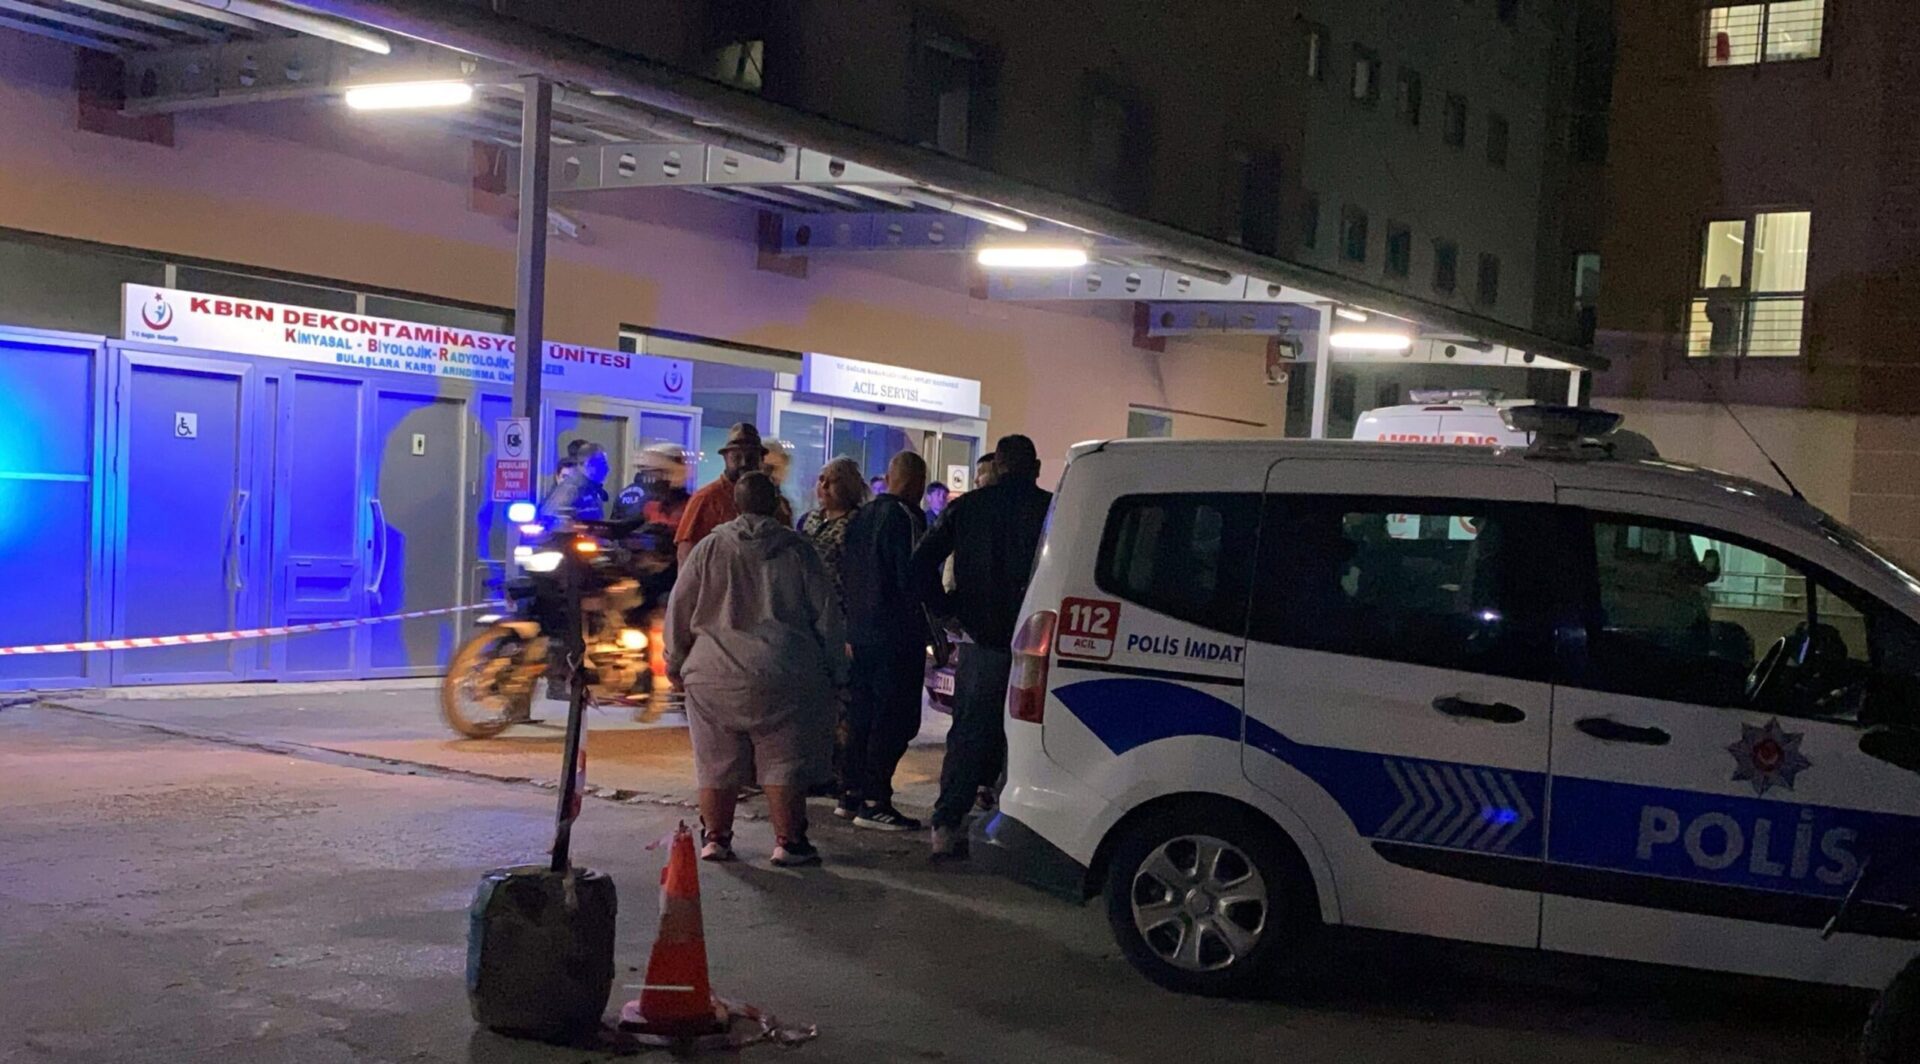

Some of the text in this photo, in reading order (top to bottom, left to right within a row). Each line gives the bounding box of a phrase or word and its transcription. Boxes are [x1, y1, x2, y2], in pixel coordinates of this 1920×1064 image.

[190, 297, 631, 369] KBRN DEKONTAMİNASYO ÜNİTESİ
[1069, 604, 1111, 635] 112
[1127, 634, 1244, 663] POLİS İMDAT
[1636, 805, 1858, 885] POLİS
